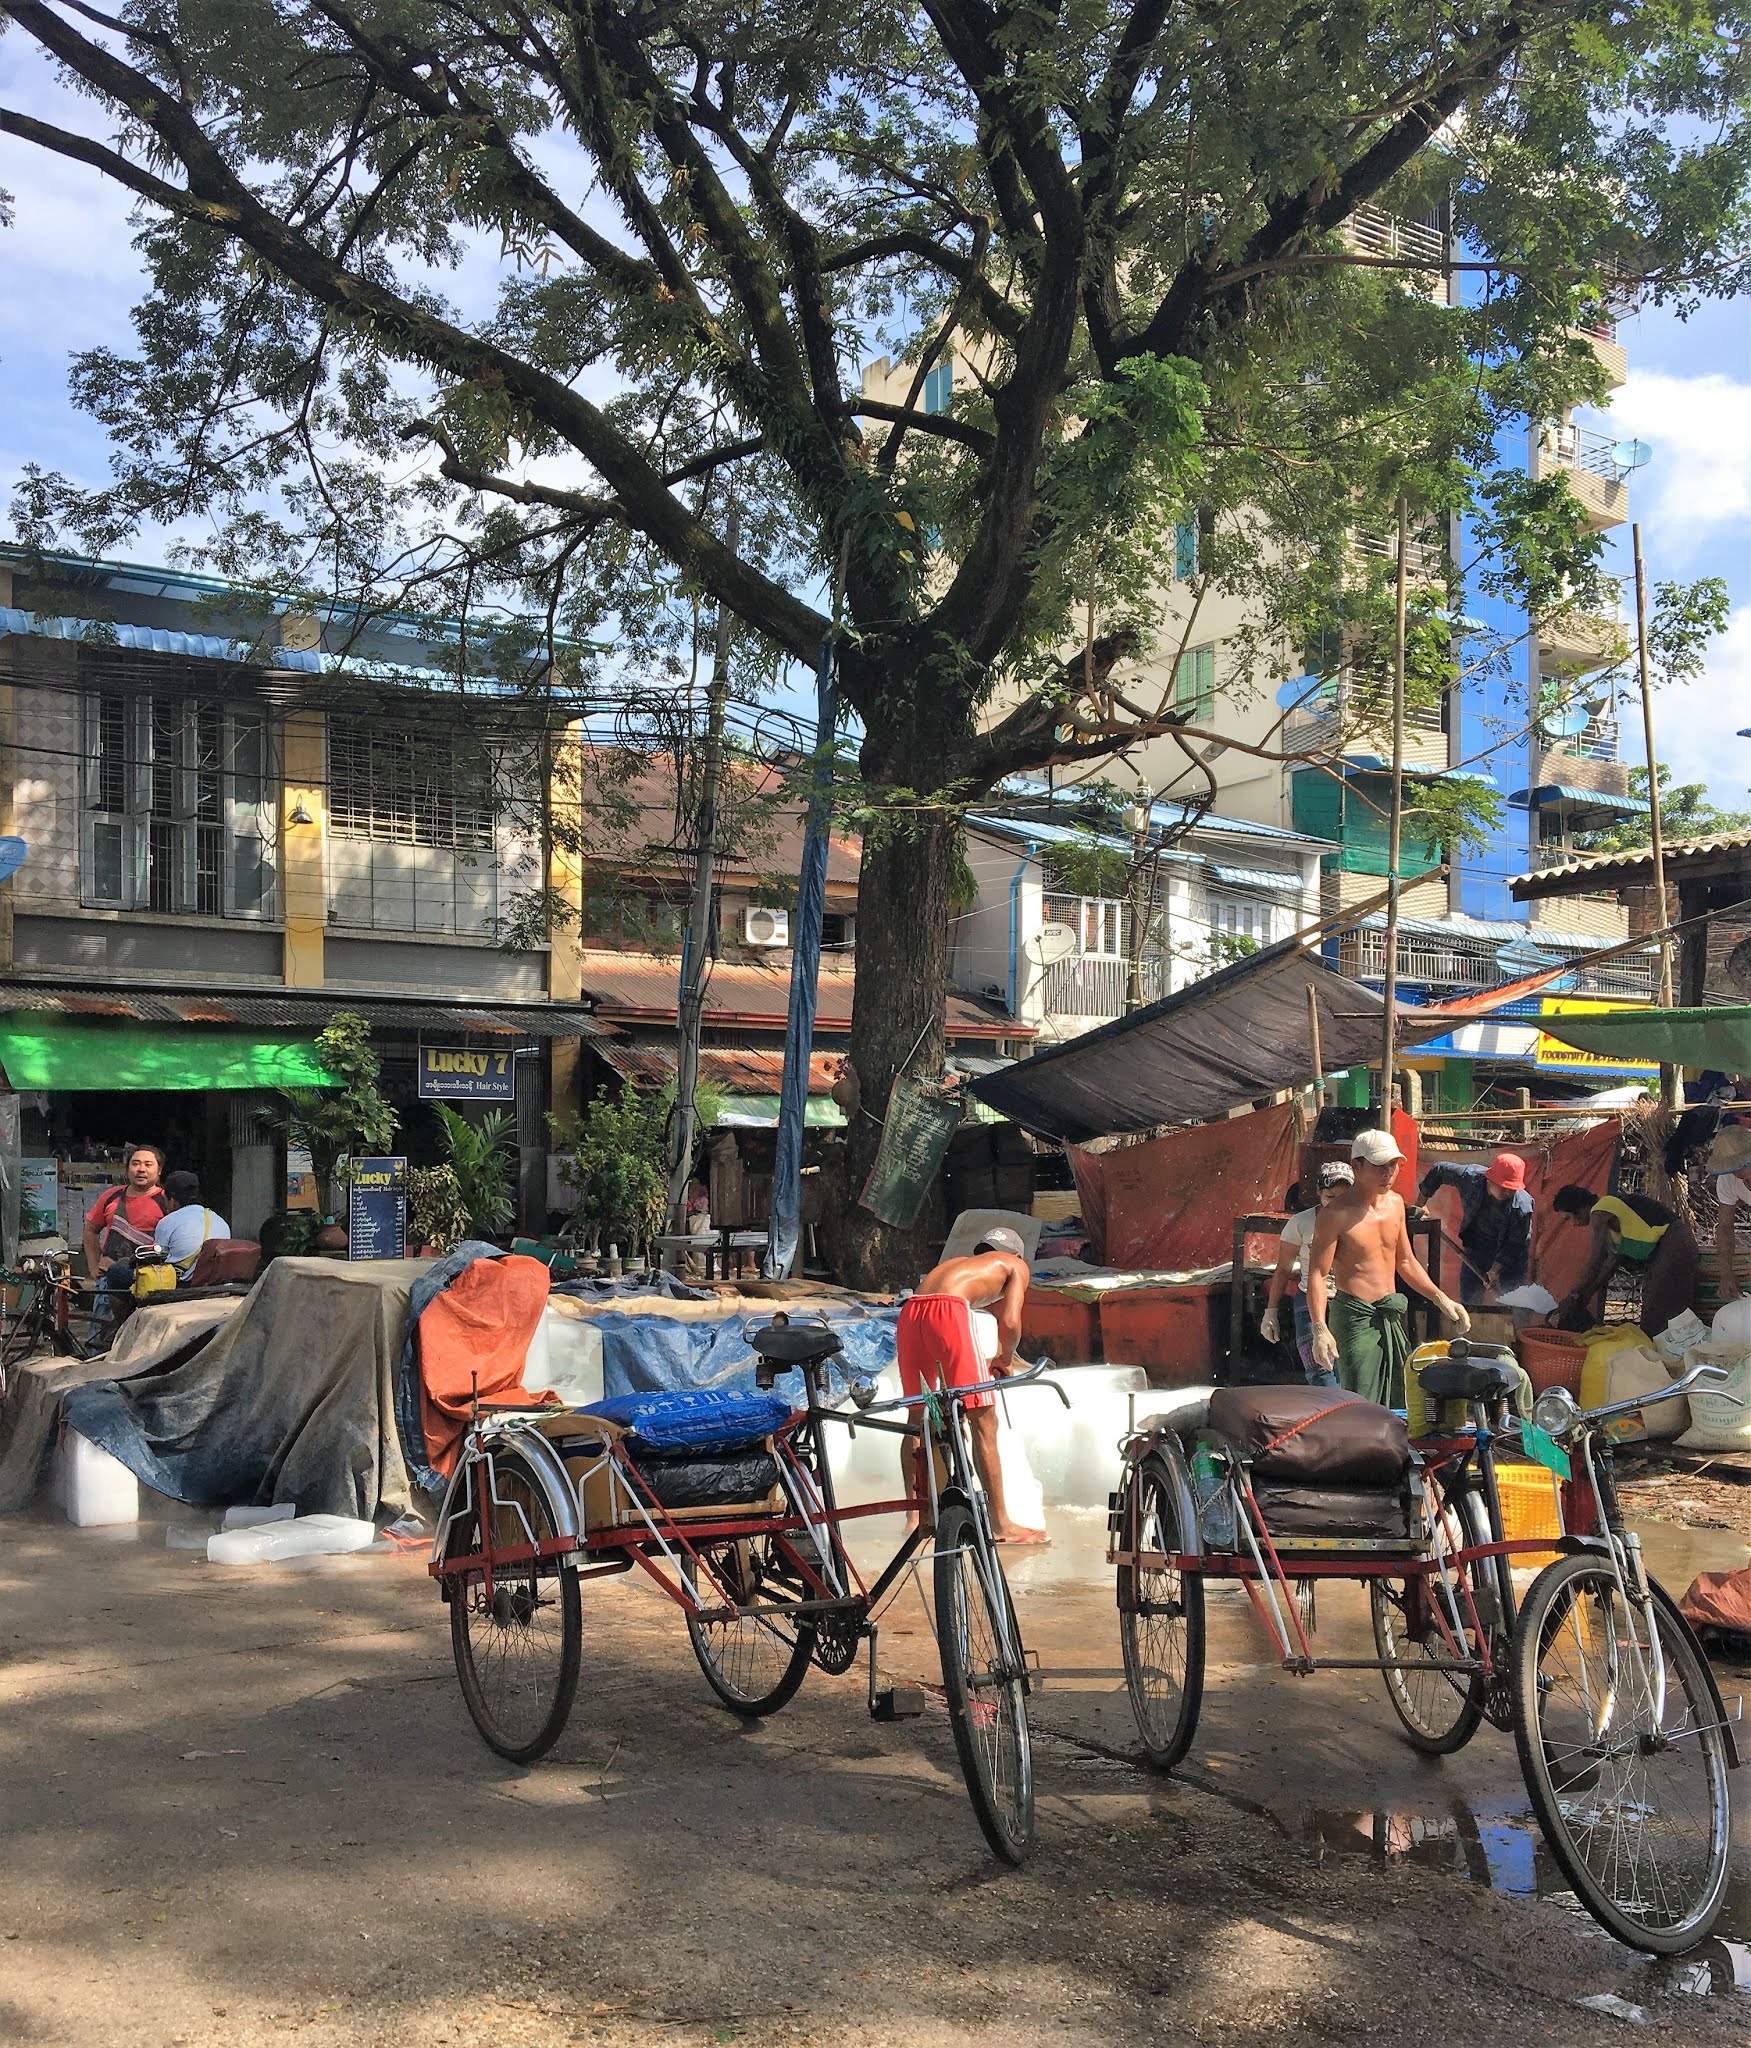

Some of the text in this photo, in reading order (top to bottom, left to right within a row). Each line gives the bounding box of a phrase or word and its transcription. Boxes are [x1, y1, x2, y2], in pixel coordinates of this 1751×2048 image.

[427, 1049, 508, 1076] Lucky 7
[476, 1081, 491, 1090] Hair
[492, 1082, 509, 1092] Style
[354, 1171, 391, 1185] Lucky
